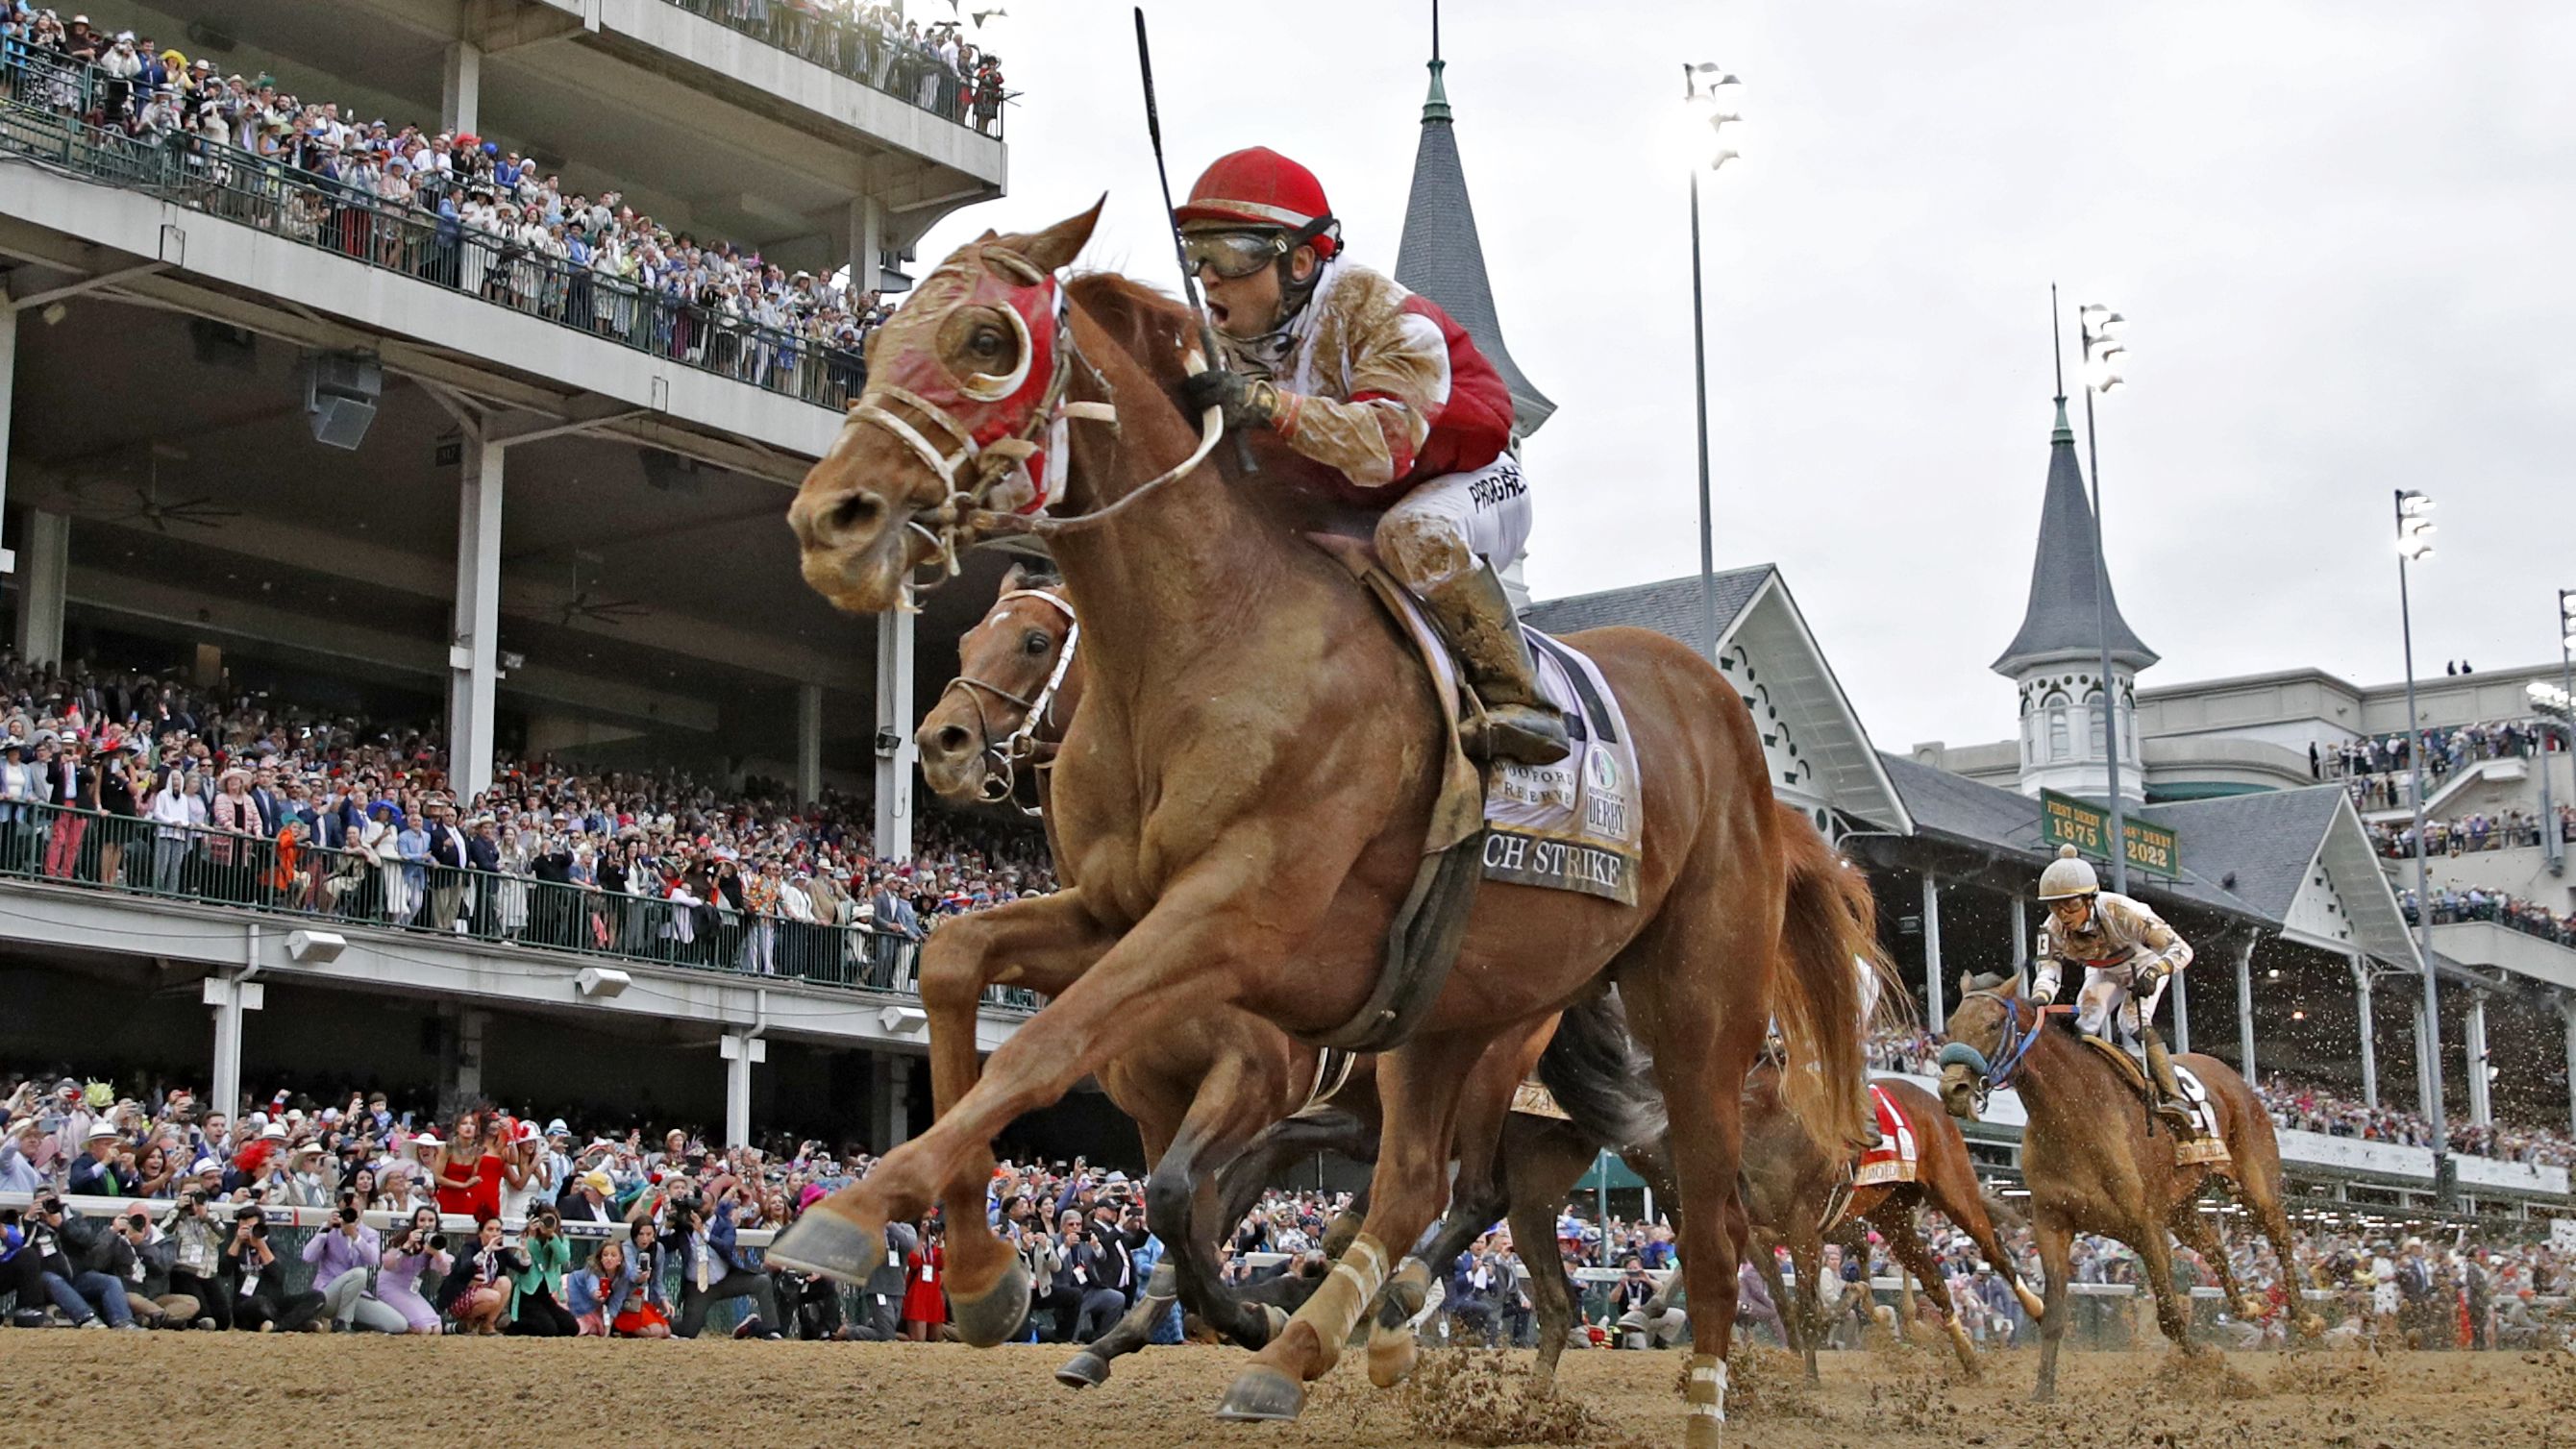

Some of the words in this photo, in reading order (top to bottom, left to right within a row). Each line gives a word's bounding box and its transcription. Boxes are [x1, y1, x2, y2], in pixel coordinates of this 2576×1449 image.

[1588, 796, 1625, 836] DERBY
[2047, 800, 2071, 818] FIRST
[2073, 808, 2099, 827] DERBY
[2053, 818, 2096, 847] 1875
[2143, 829, 2170, 848] DERBY
[1533, 841, 1621, 888] STRIKE
[2127, 839, 2168, 868] 2022
[2037, 933, 2049, 956] 13
